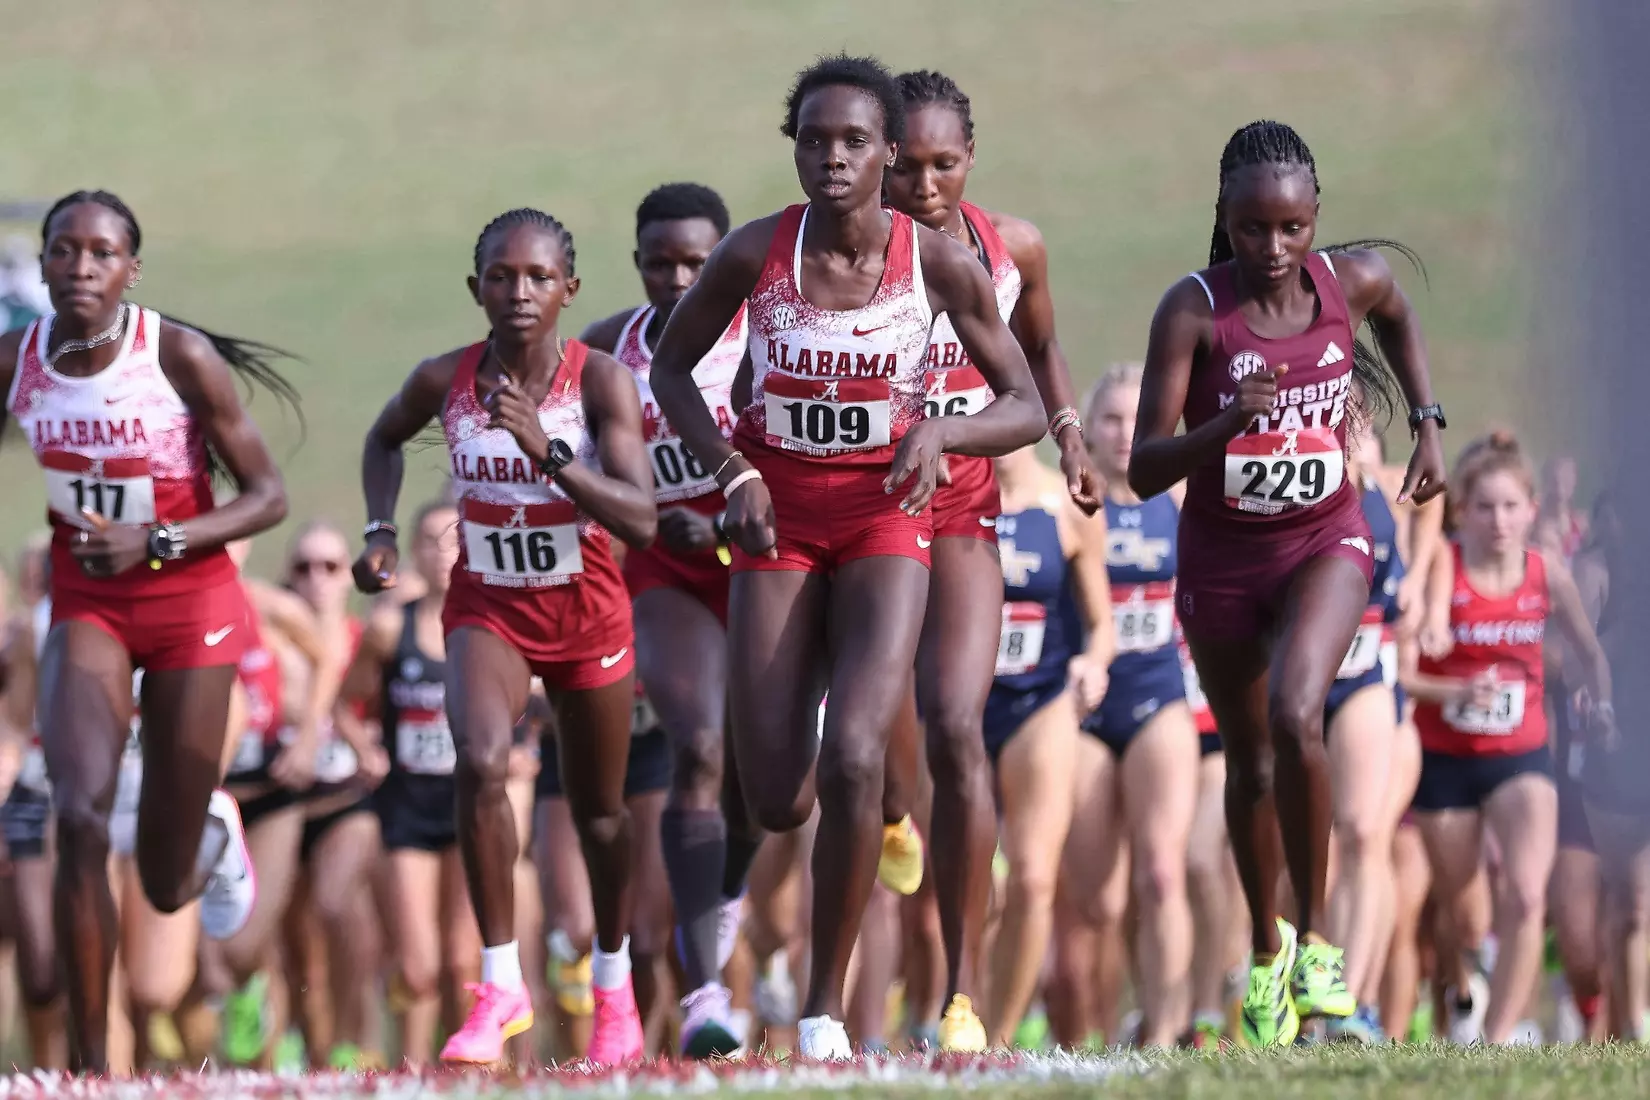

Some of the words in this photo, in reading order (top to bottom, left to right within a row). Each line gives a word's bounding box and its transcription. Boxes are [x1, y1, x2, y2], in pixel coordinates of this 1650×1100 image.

[767, 338, 897, 378] ALABAMA
[783, 402, 869, 445] 109
[1235, 390, 1349, 438] TATE
[652, 443, 710, 489] 08
[1241, 459, 1325, 502] 229
[68, 479, 124, 520] 117
[484, 531, 557, 573] 116
